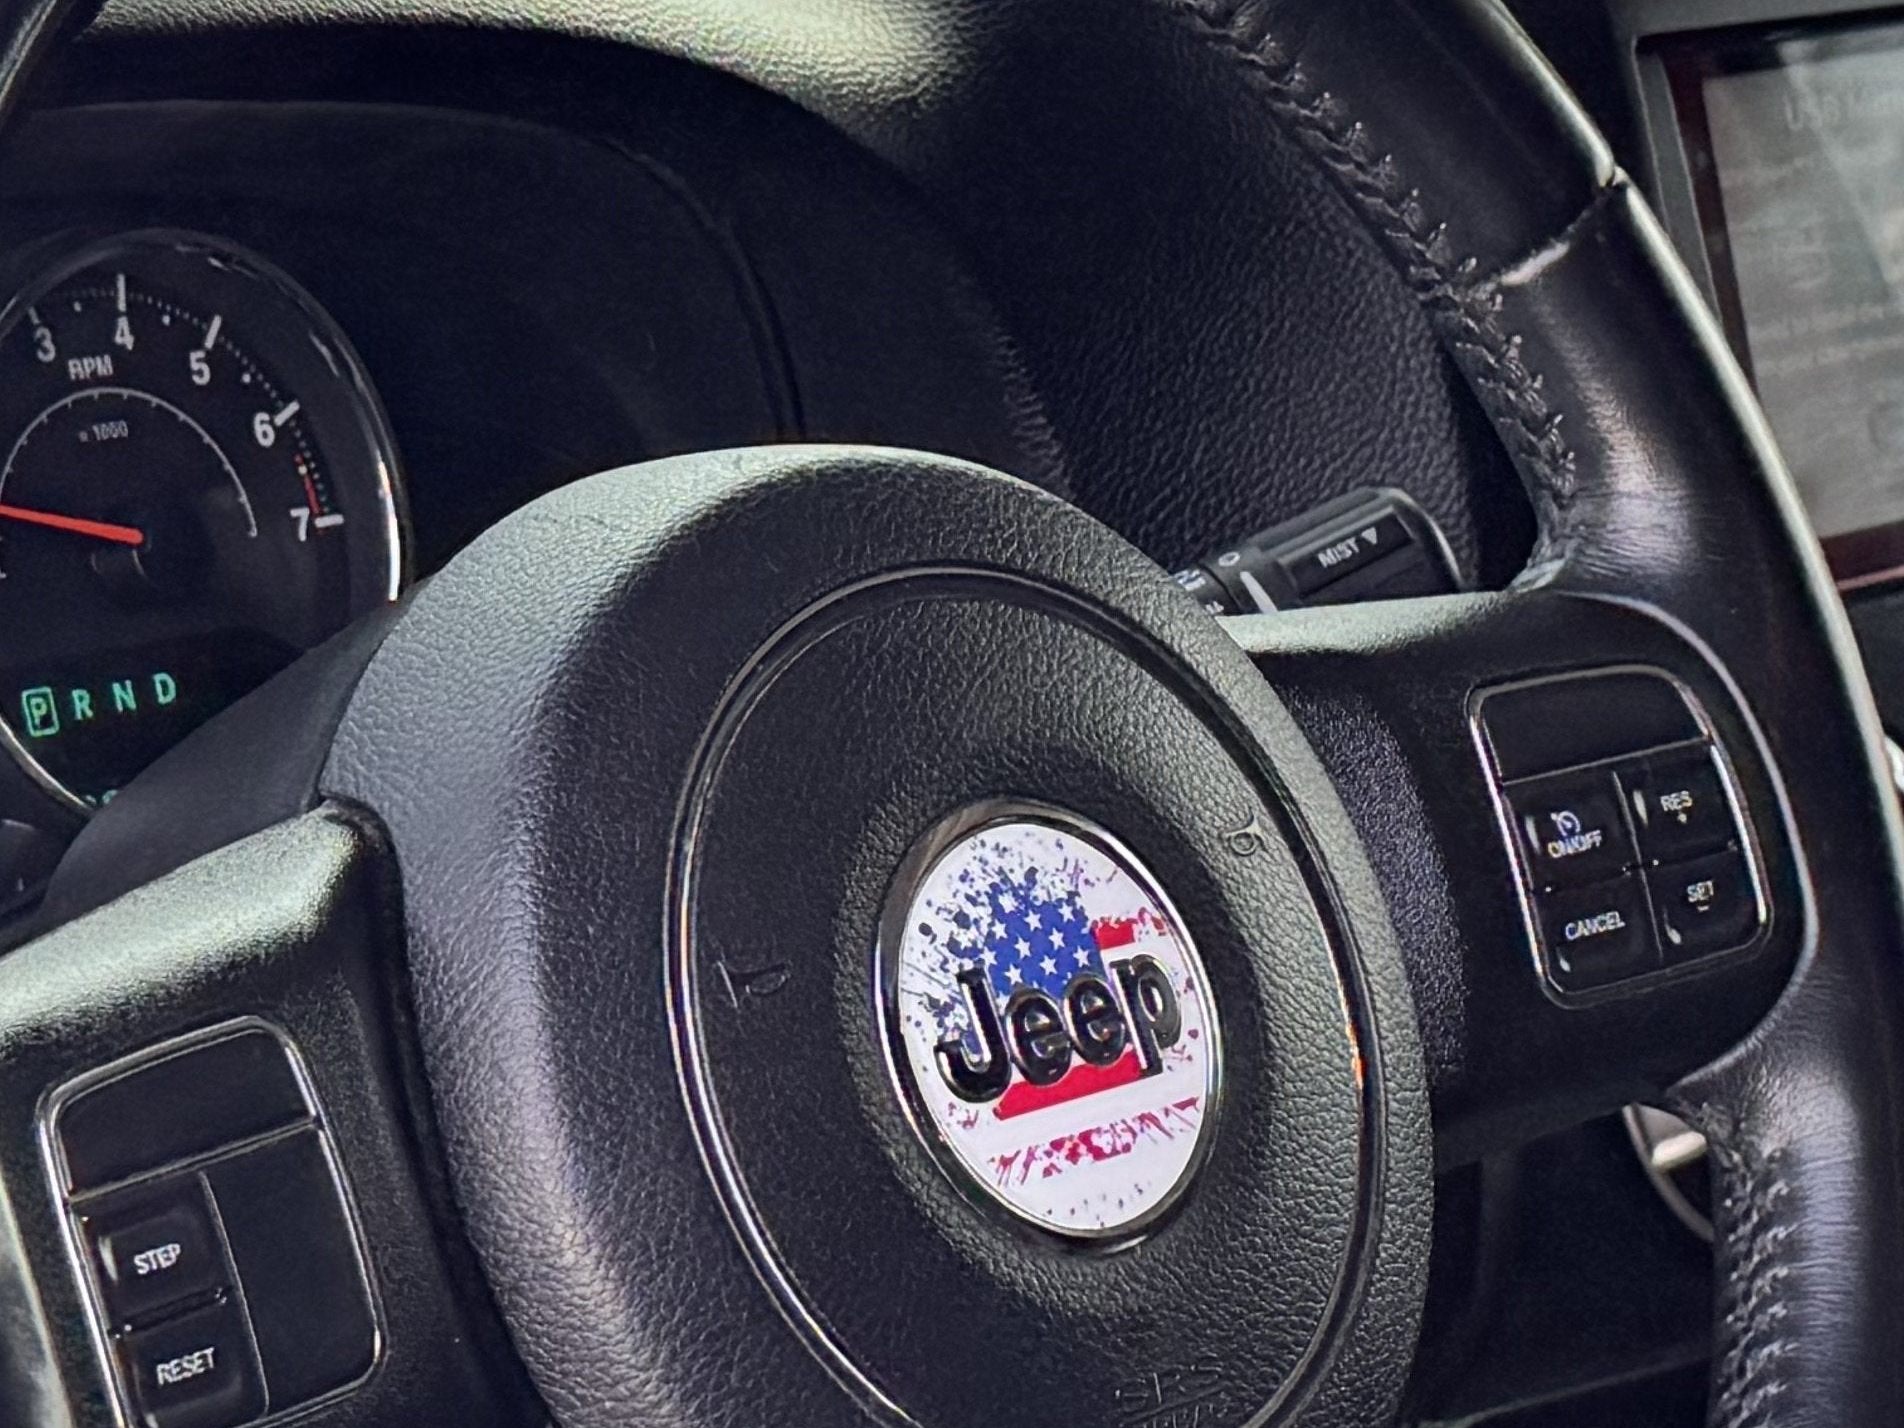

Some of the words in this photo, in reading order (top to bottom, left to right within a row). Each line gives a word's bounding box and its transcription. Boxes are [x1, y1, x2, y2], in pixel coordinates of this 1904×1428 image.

[34, 326, 56, 363] 3
[114, 316, 134, 351] 4
[67, 354, 114, 381] RPM
[189, 351, 211, 385] 5
[254, 412, 276, 447] 6
[290, 507, 311, 542] 7
[1317, 536, 1360, 569] MIST
[72, 688, 94, 720] R
[112, 679, 137, 713] N
[152, 672, 177, 705] D
[1660, 790, 1693, 813] RES
[1565, 911, 1626, 941] CANCEL
[933, 954, 1181, 1103] Jeep
[133, 1242, 182, 1275] STEP
[155, 1346, 217, 1386] RESET
